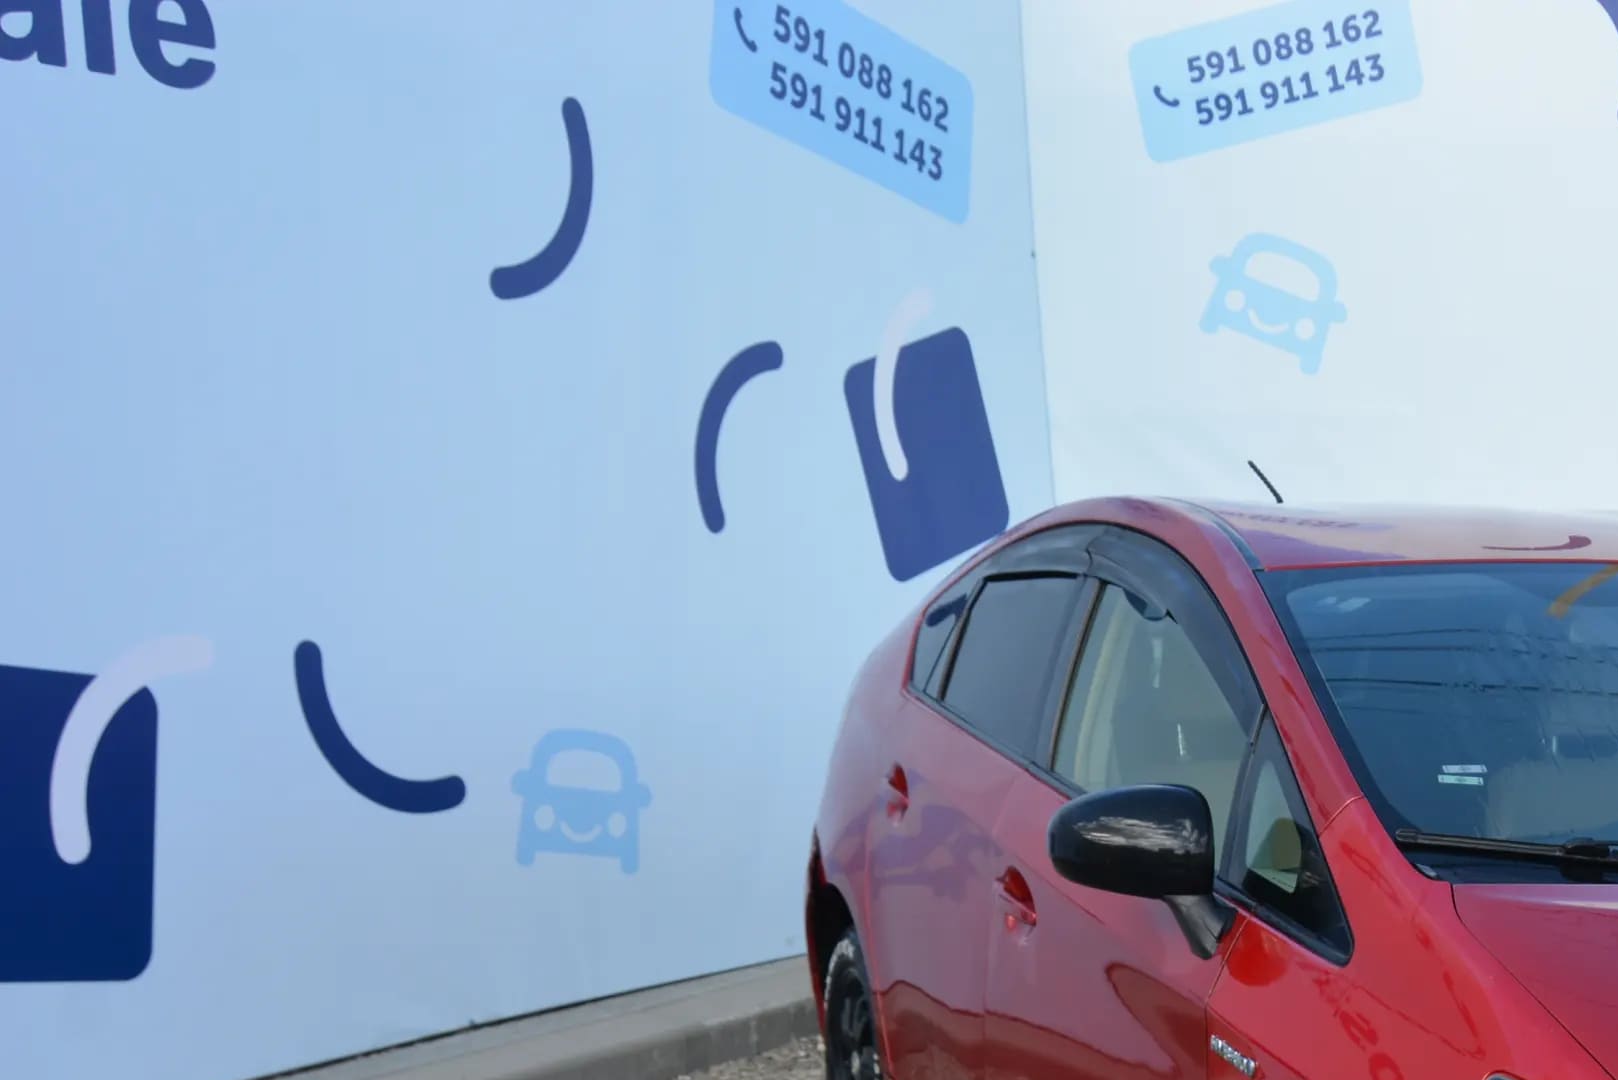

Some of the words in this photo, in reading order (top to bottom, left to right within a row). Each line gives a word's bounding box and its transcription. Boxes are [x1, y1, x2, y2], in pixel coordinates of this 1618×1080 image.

[773, 4, 829, 67] 591
[837, 41, 893, 100] 088
[901, 78, 949, 133] 162
[1186, 45, 1246, 84] 591
[1251, 26, 1315, 67] 088
[1322, 9, 1383, 50] 162
[1194, 88, 1255, 126] 591
[1259, 71, 1320, 109] 911
[1325, 53, 1386, 95] 143
[769, 61, 826, 122] 591
[834, 96, 886, 154] 911
[892, 128, 943, 182] 143
